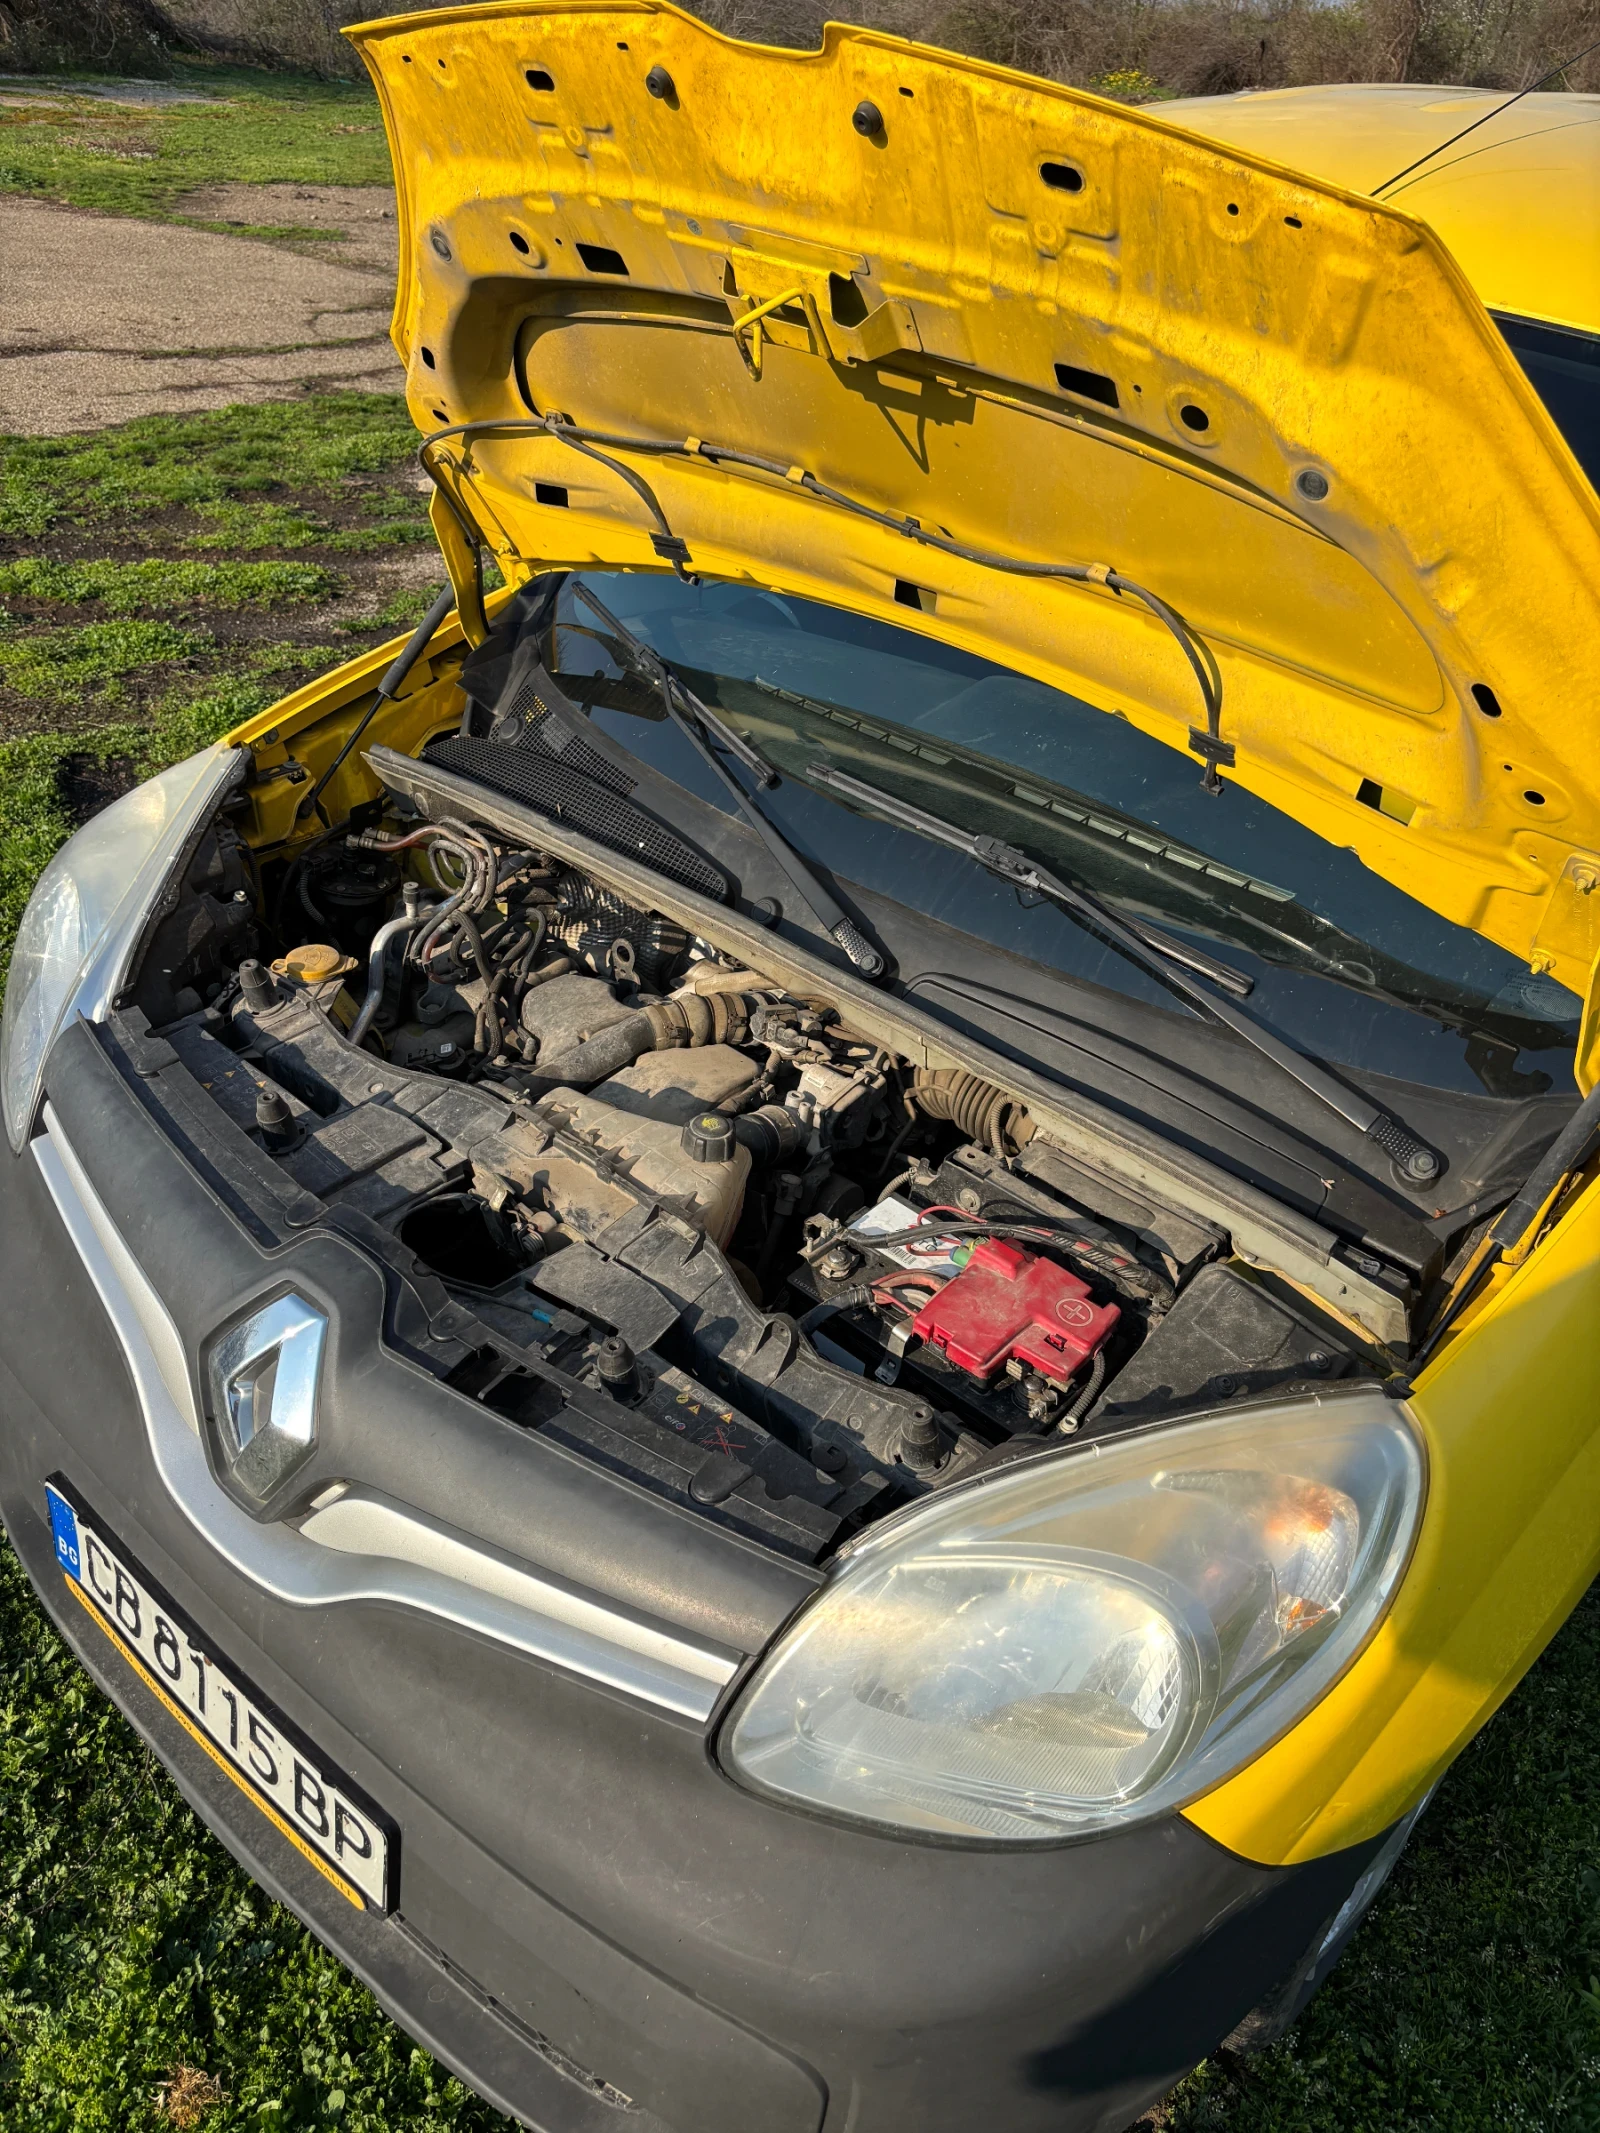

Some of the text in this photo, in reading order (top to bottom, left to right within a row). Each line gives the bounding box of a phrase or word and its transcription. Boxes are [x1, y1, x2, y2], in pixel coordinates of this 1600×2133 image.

[58, 1535, 78, 1566] BG
[85, 1535, 373, 1859] CB 8115 BP
[299, 1842, 354, 1897] RENAULT
